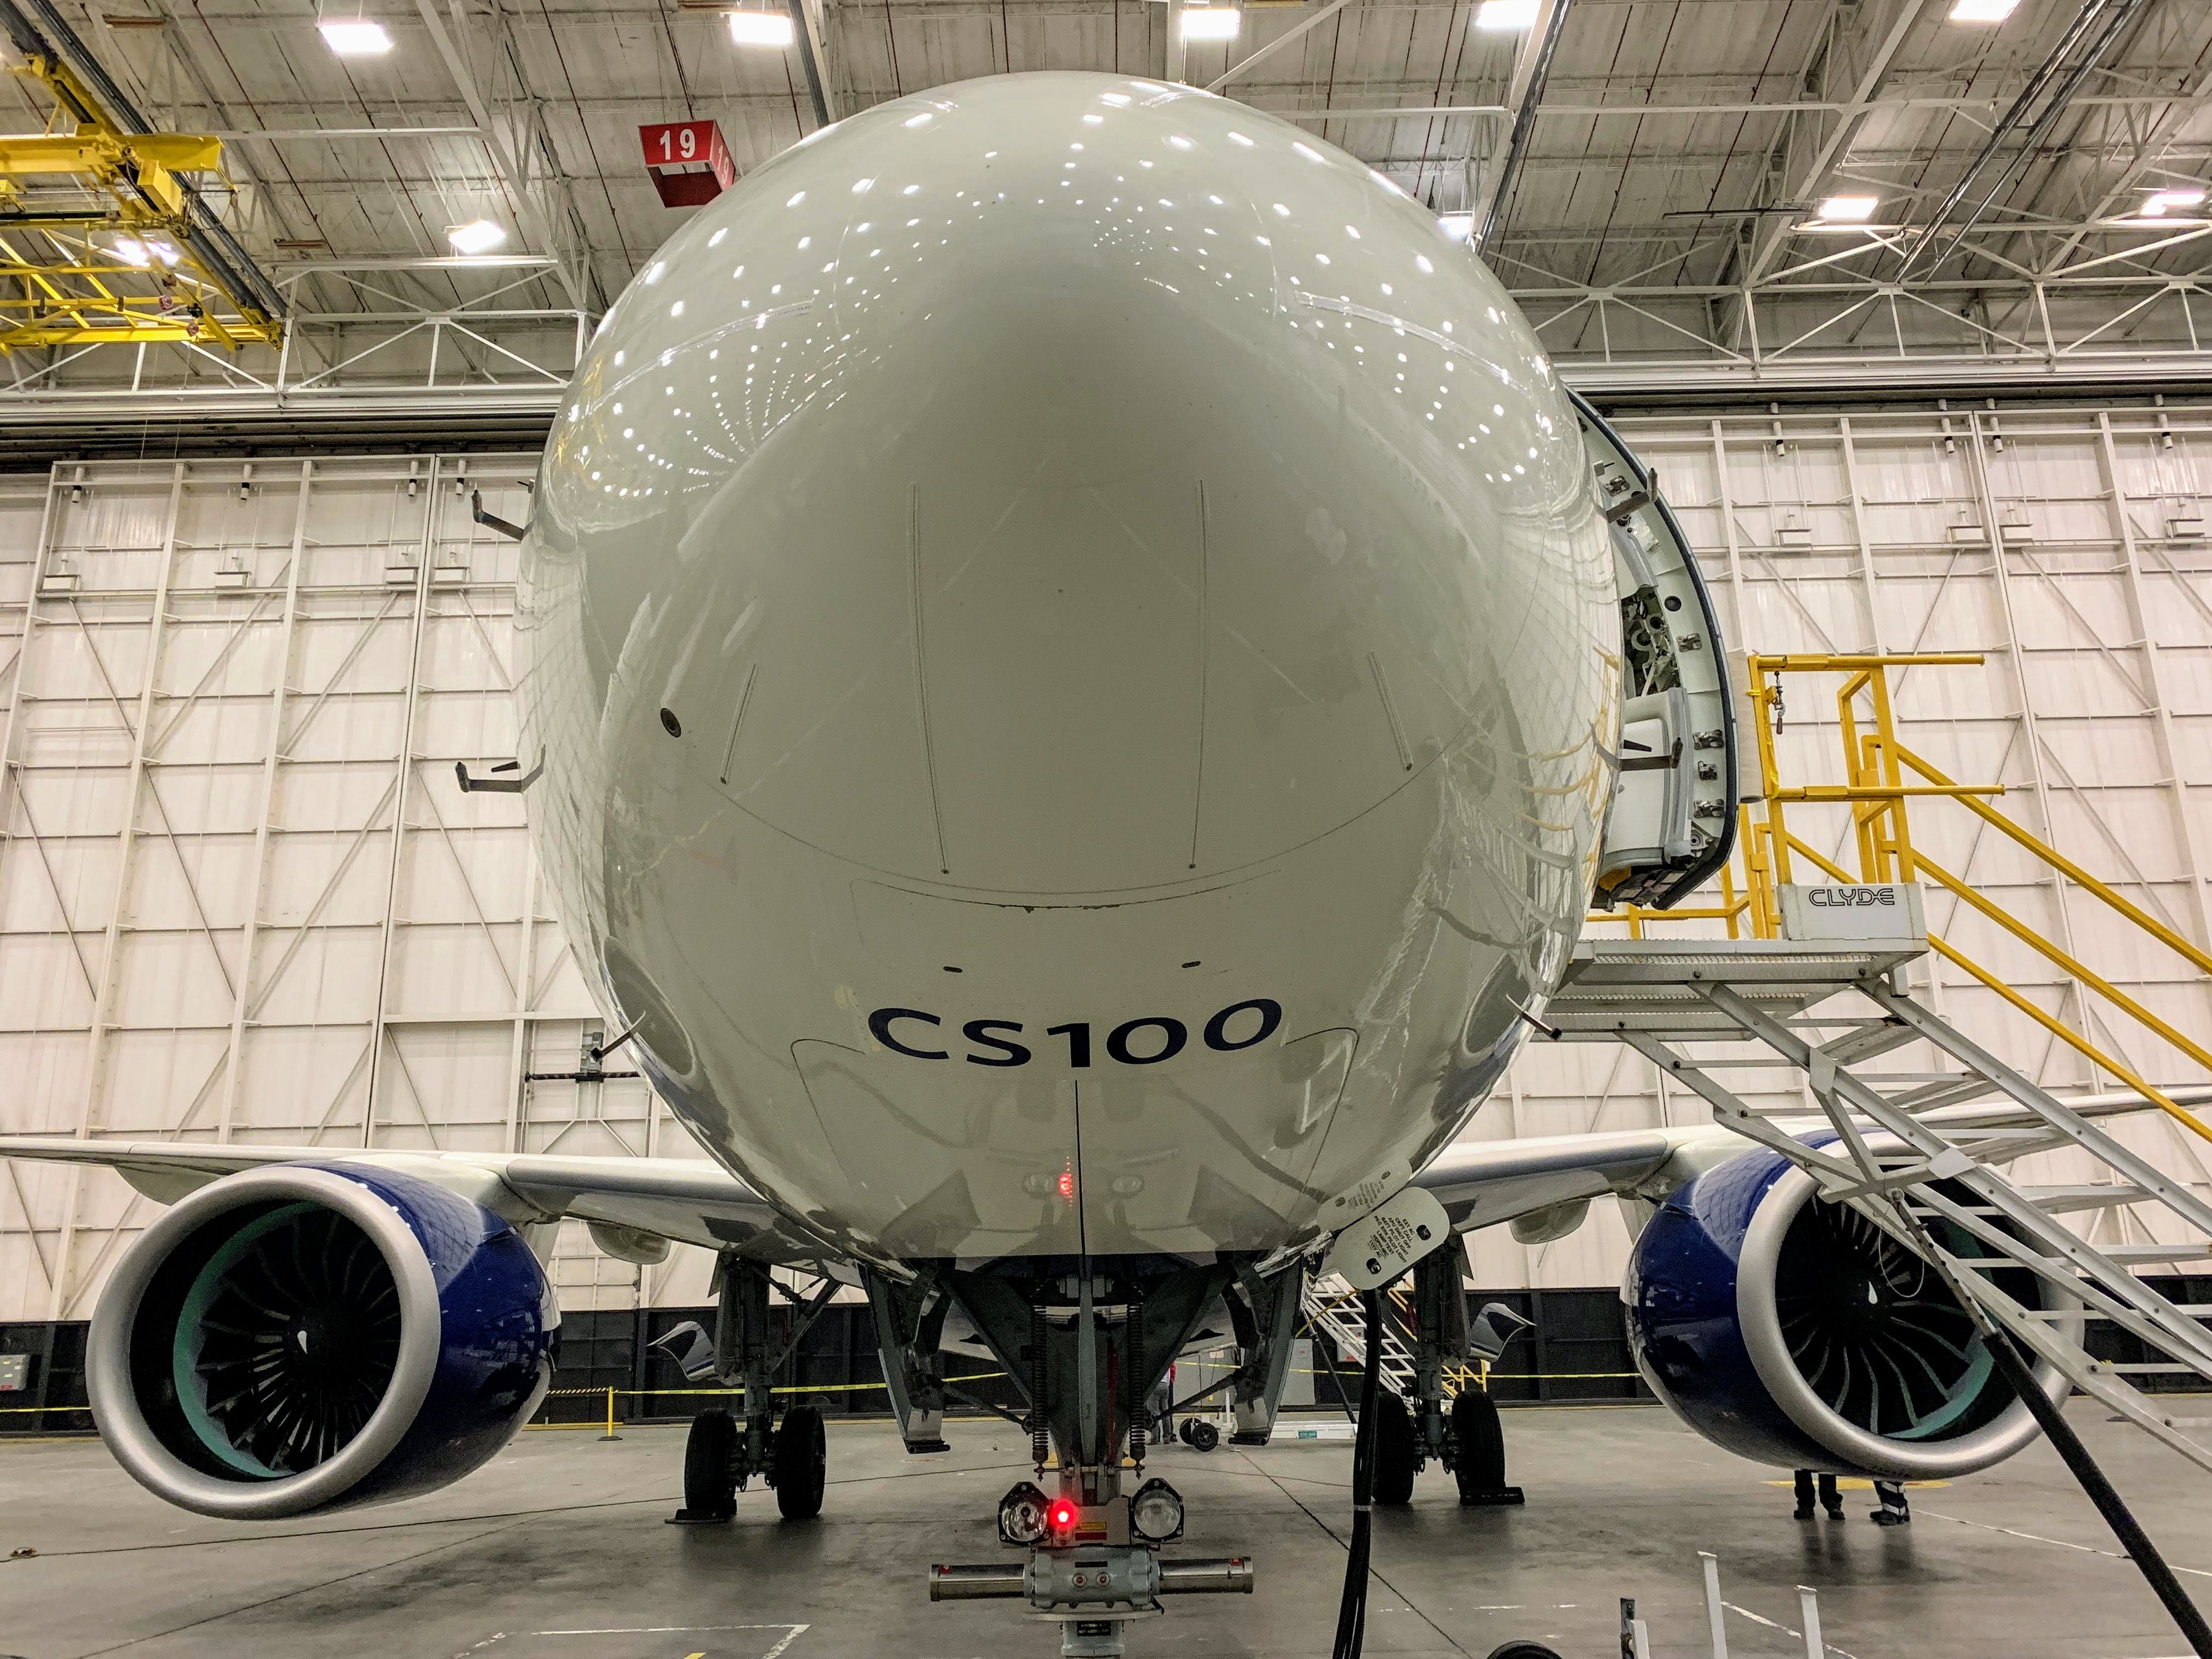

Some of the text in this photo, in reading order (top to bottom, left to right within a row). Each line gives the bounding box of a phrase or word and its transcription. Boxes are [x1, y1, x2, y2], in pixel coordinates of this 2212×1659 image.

[660, 128, 696, 160] 19
[717, 145, 729, 185] 19
[1809, 888, 1895, 907] CLYDE
[868, 998, 1283, 1068] CS100
[1376, 1230, 1387, 1243] LAMP
[1389, 1229, 1399, 1241] PILOT
[1387, 1236, 1398, 1249] PILOT
[1396, 1249, 1407, 1263] LIGHT
